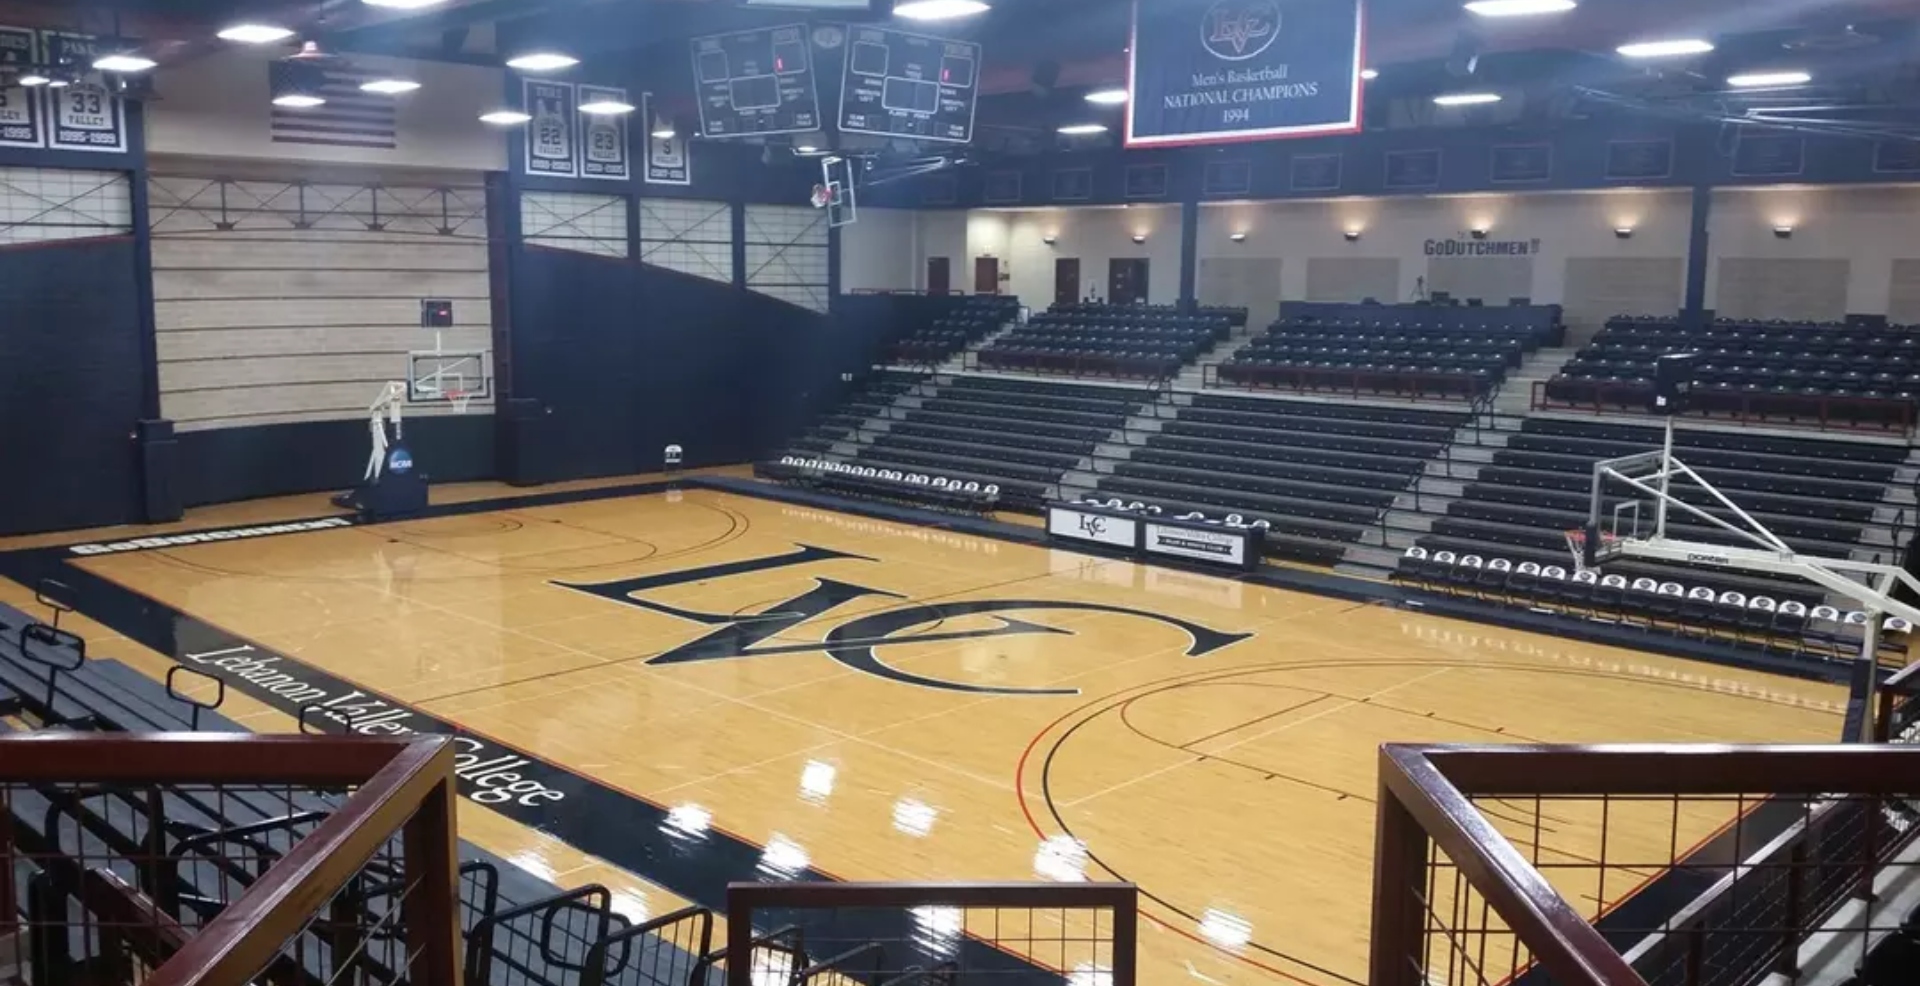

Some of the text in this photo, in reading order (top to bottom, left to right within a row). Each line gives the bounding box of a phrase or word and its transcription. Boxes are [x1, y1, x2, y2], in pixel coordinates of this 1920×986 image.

[1192, 64, 1288, 87] Men's Basketball
[71, 92, 101, 114] 33
[1164, 82, 1319, 109] NATIONAL CHAMPIONS
[69, 115, 104, 126] VALLEY
[1223, 108, 1249, 123] 1994
[540, 127, 562, 146] 22
[594, 132, 614, 150] 23
[1079, 514, 1107, 537] LVC
[549, 542, 1255, 695] LVC
[185, 644, 328, 712] Lebanon
